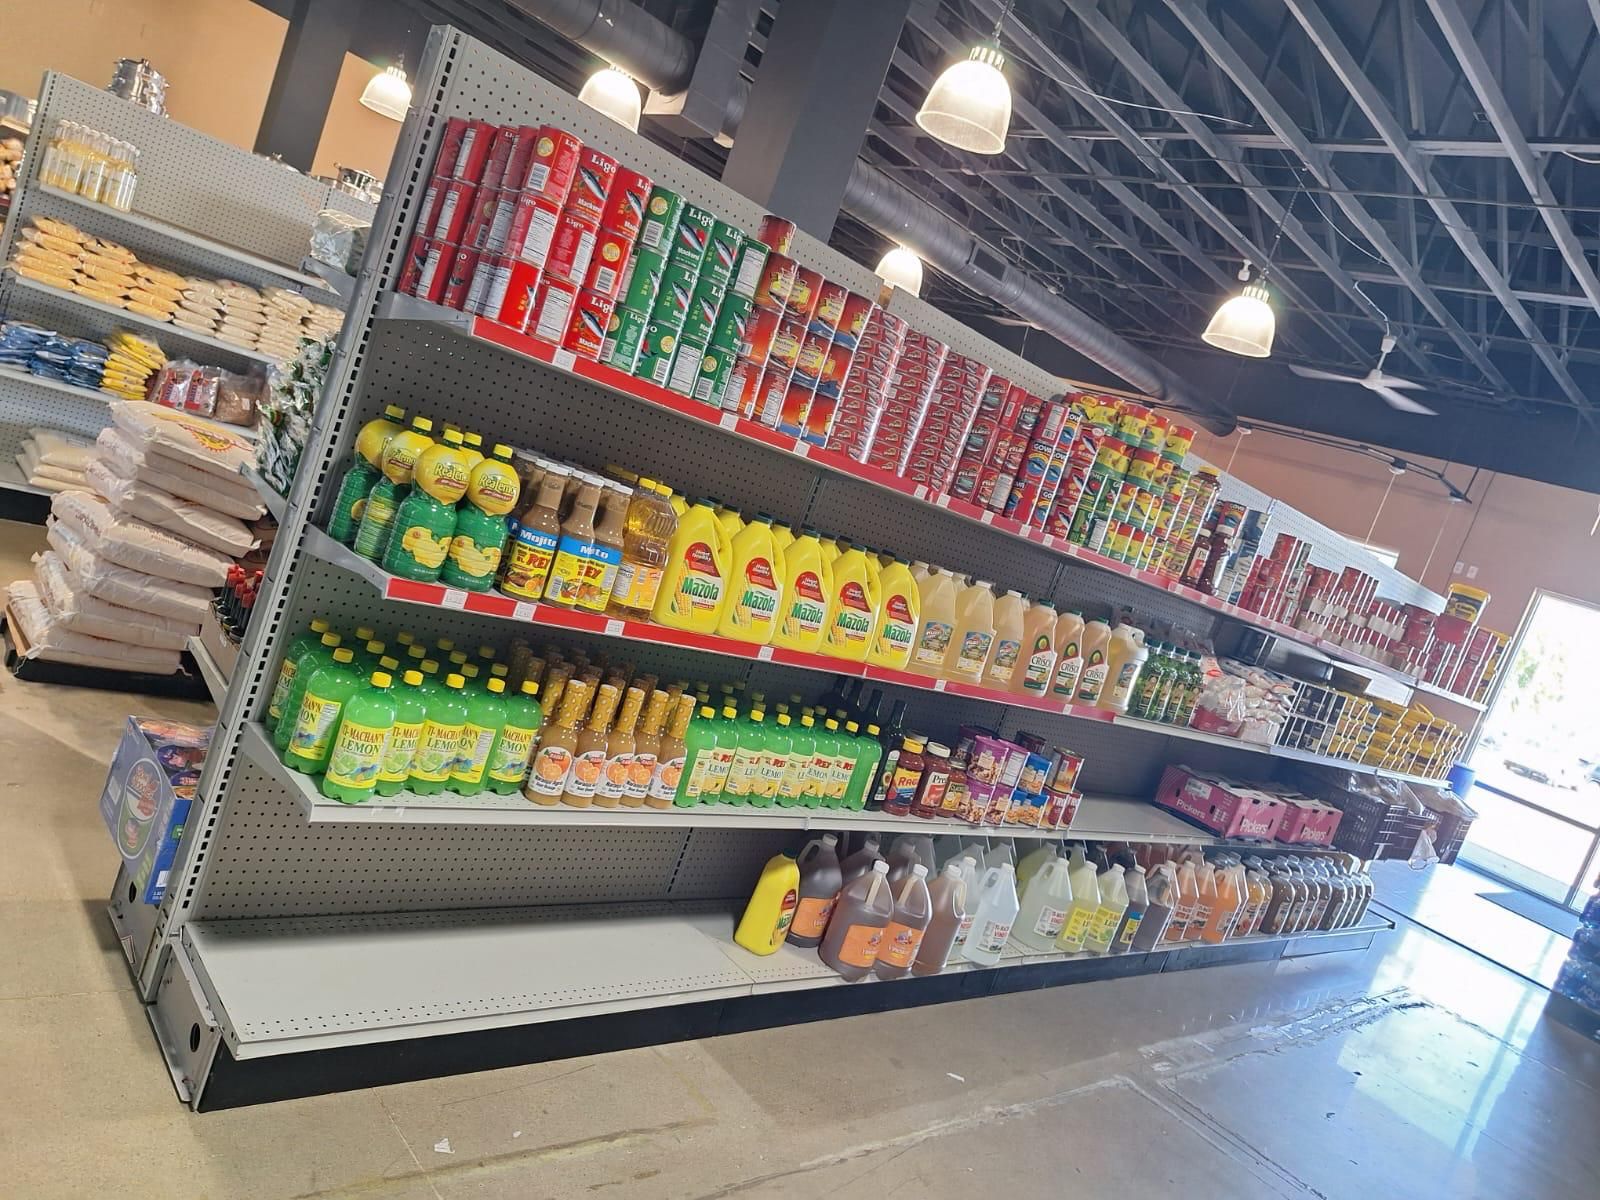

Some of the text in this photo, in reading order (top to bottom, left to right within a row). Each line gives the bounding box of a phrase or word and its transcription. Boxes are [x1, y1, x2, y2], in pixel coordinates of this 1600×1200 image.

[591, 154, 617, 174] Ligo
[565, 217, 585, 229] Ligo
[688, 207, 714, 227] Ligo
[681, 577, 720, 601] Mazola
[741, 590, 776, 613] Mazola
[791, 602, 824, 624] Mazola
[836, 612, 870, 633] Mazola
[883, 624, 912, 644] Mazola
[340, 739, 381, 755] LEMON
[500, 740, 528, 752] EMON
[843, 762, 854, 771] RE
[897, 776, 919, 787] RAG
[1176, 798, 1206, 820] Pickers
[1239, 817, 1269, 834] Pickers
[1301, 827, 1327, 842] Pickers
